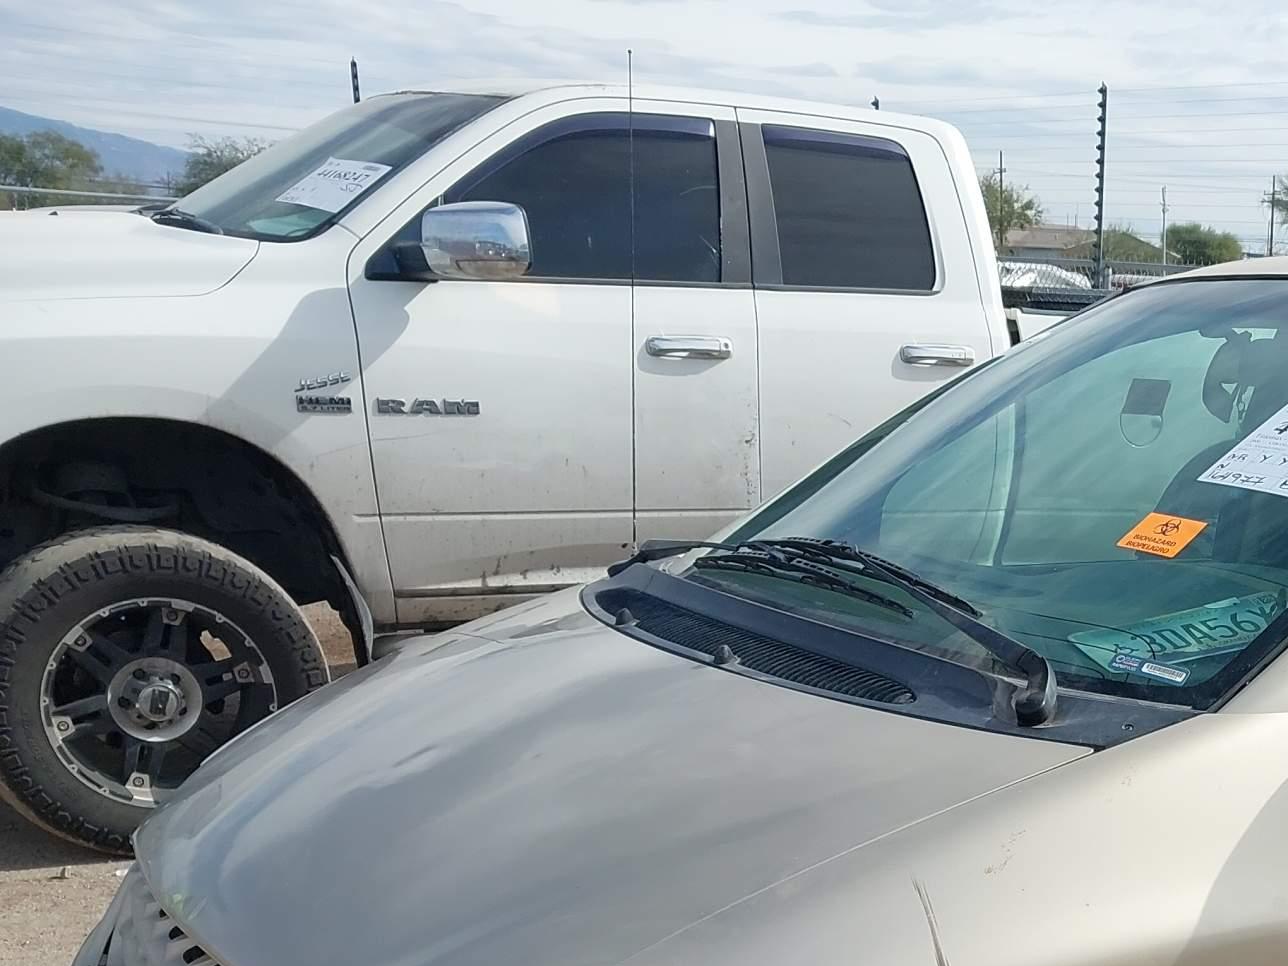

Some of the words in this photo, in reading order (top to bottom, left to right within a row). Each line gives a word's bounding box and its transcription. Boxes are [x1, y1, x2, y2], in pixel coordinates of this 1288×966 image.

[294, 371, 351, 392] JESSE
[376, 398, 480, 416] RAM
[1126, 541, 1170, 554] BIOPELIGRO
[1133, 534, 1177, 547] BIOHAZARD
